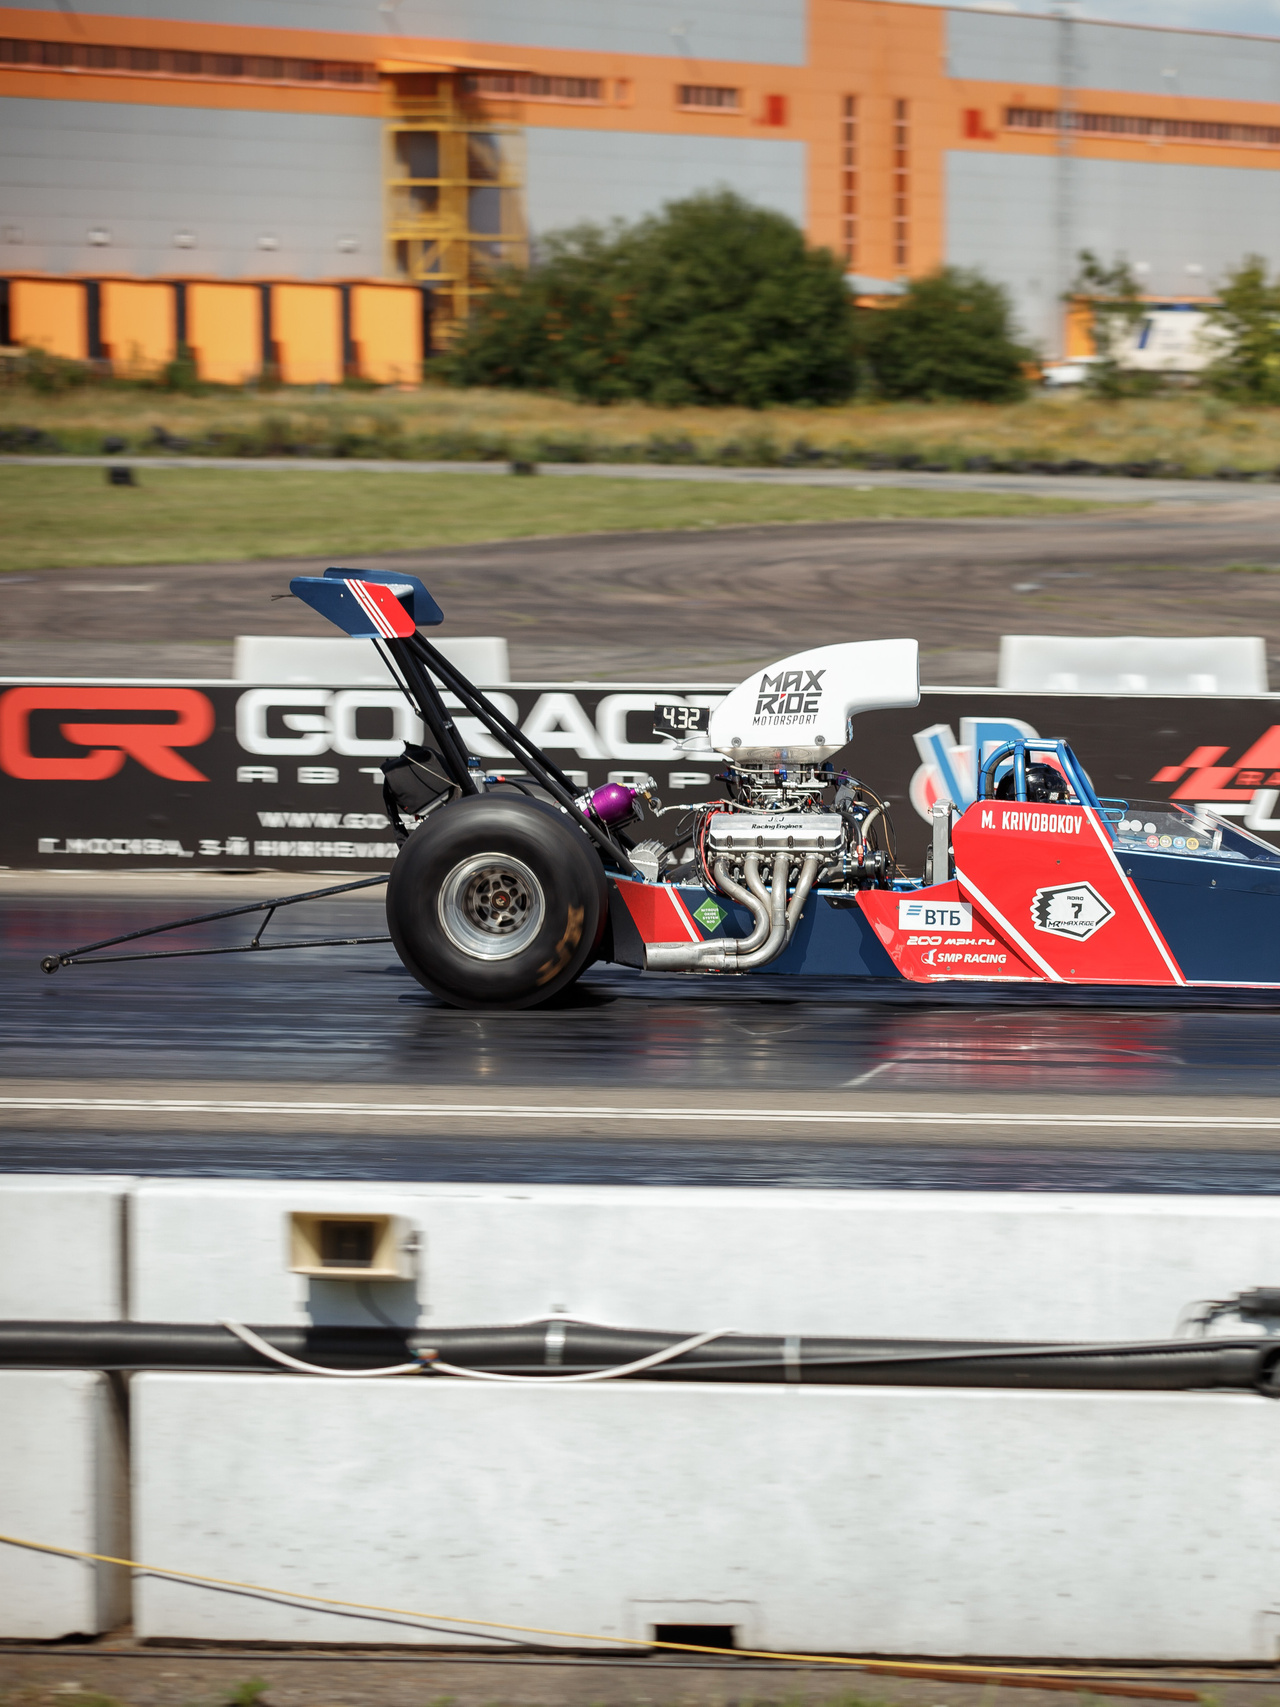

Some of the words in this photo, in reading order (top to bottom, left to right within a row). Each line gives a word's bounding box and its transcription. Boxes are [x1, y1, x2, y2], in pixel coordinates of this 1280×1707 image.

[759, 669, 827, 693] MAX
[755, 692, 822, 715] RIDE
[663, 706, 700, 730] 4.32
[752, 714, 818, 726] MOTORSPORT
[751, 823, 776, 831] Racing
[981, 809, 996, 830] M.
[1002, 811, 1082, 835] KRIVOBOKOV
[925, 909, 961, 926] ВТБ
[1071, 903, 1083, 919] 7
[906, 935, 943, 946] 200
[937, 953, 963, 963] SMP
[963, 953, 1007, 964] RACING
